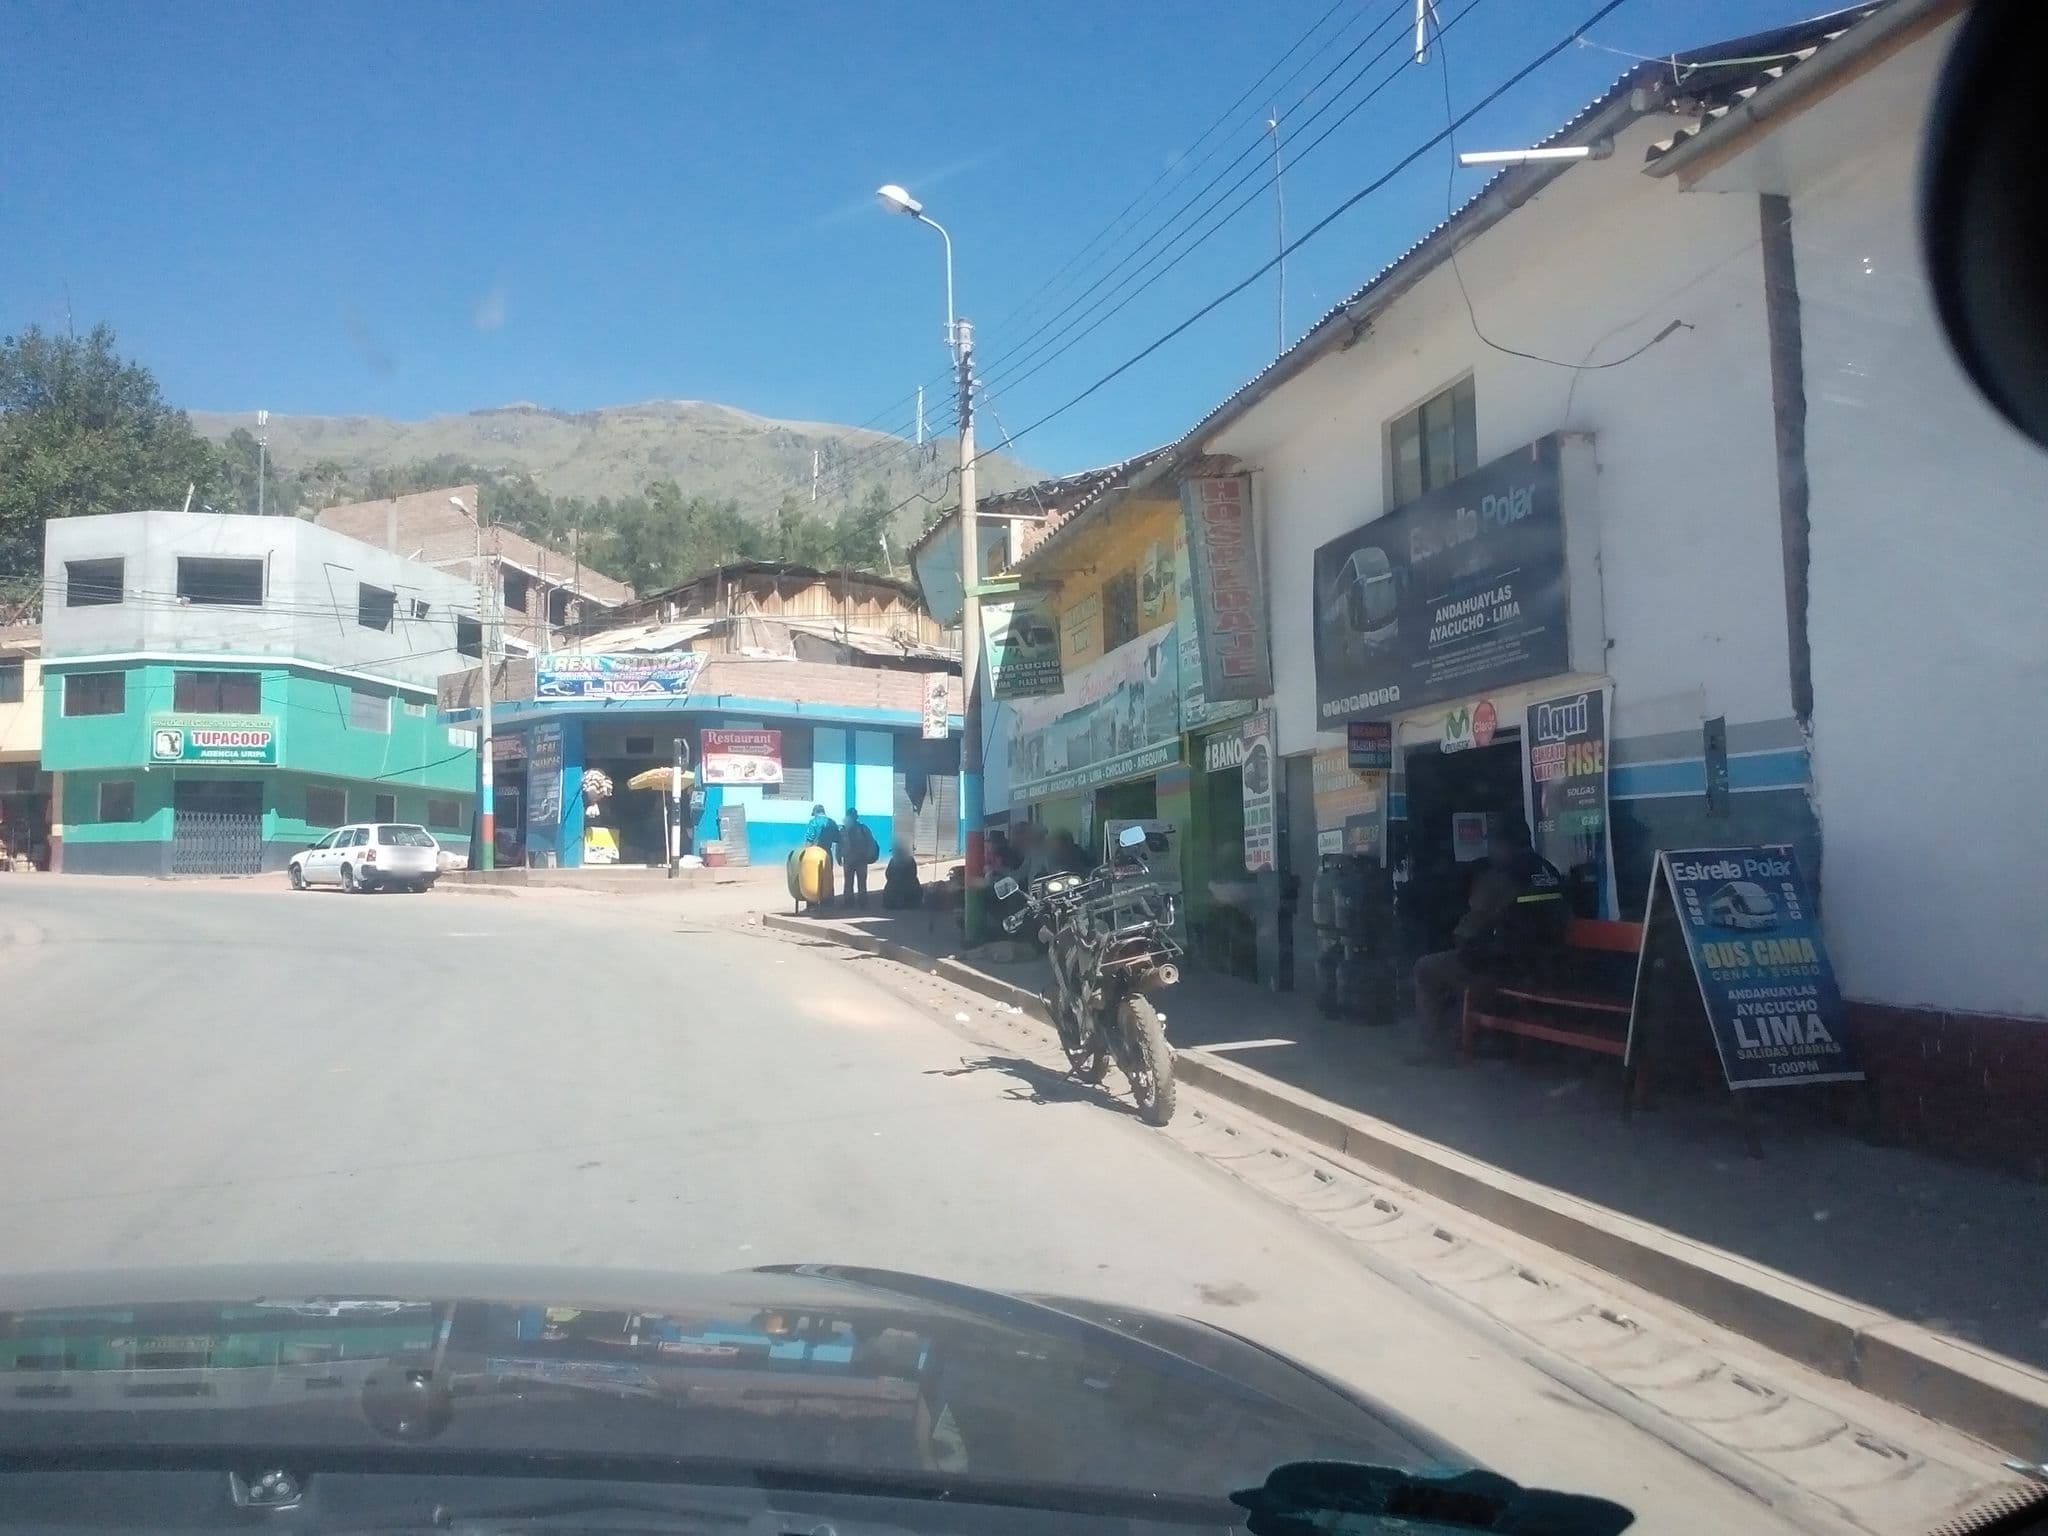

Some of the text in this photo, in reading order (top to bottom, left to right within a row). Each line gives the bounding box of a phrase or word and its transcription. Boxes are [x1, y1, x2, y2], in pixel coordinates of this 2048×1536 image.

[1482, 482, 1535, 534] Polar
[1200, 479, 1257, 678] HOSPEDAJE
[1435, 584, 1512, 623] ANDAHUAYLAS
[1429, 612, 1483, 643] AYACUCHO
[1493, 601, 1520, 623] LIMA
[584, 681, 665, 693] LIMA
[1538, 695, 1588, 741] Aquí
[192, 730, 271, 747] TUPACOOP
[708, 731, 771, 745] Restaurant
[1137, 748, 1168, 769] AREQUIPA
[1567, 740, 1603, 777] FISE
[1567, 785, 1597, 797] SOLGAS
[1671, 858, 1791, 881] Estrella Polar
[1702, 937, 1818, 969] BUS CAMA
[1712, 969, 1751, 981] CENA
[1757, 968, 1766, 978] A
[1727, 985, 1817, 1000] ANDAHUAYLAS
[1736, 999, 1818, 1016] AYACUCHO
[1733, 1014, 1833, 1048] LIMA
[1737, 1042, 1842, 1060] SALIDAS DIARIAS
[1768, 1061, 1819, 1075] 7:00PM
